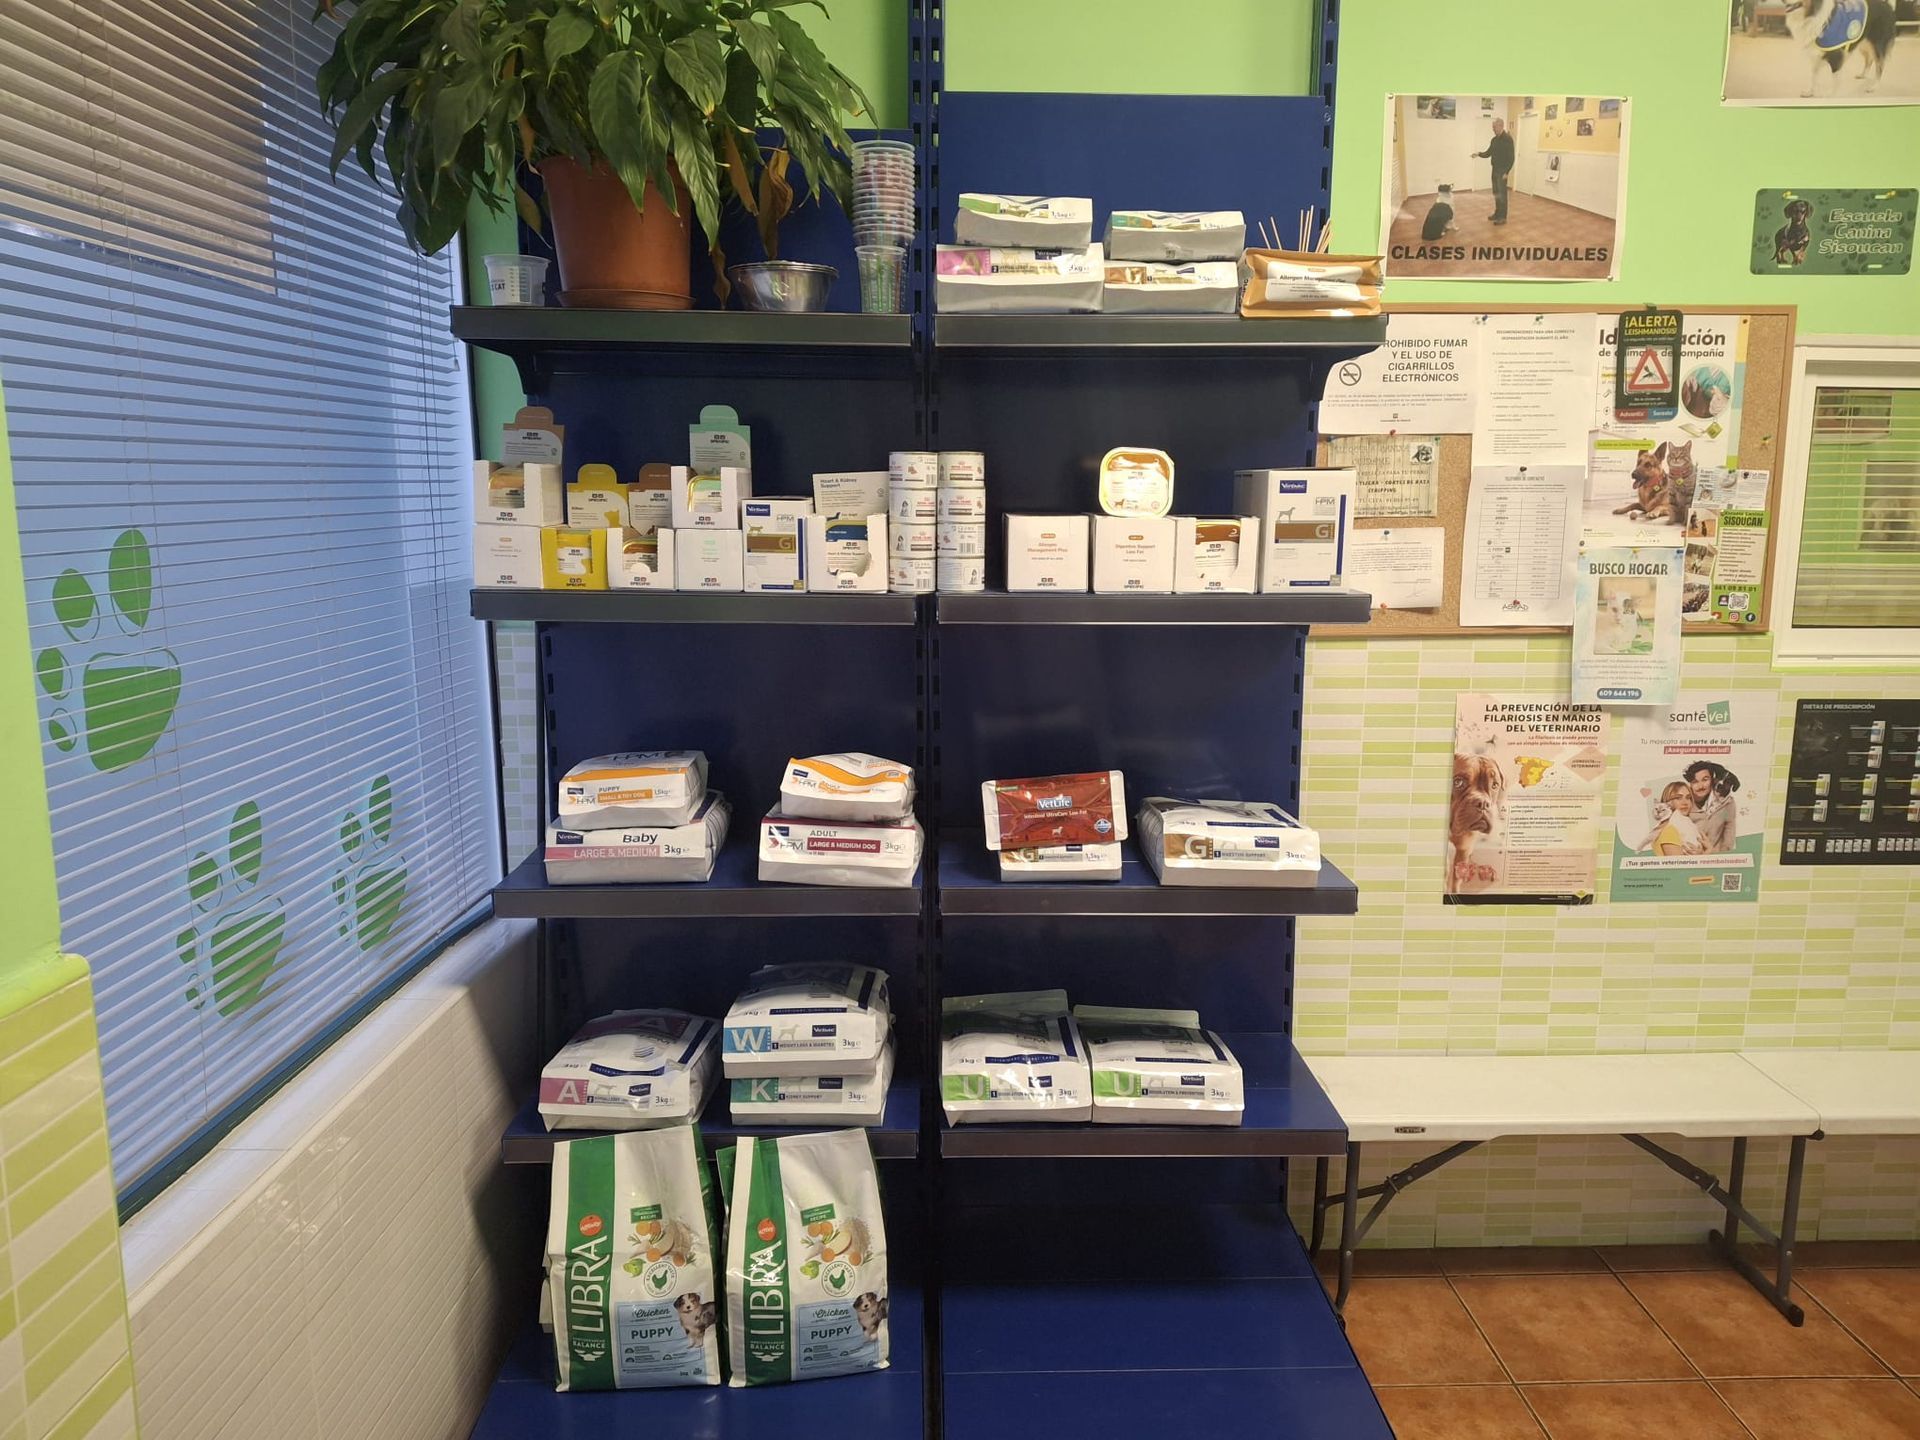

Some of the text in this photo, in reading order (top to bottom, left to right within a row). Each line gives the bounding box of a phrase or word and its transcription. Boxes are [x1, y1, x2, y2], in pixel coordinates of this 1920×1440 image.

[1829, 209, 1902, 223] Escuela
[1835, 224, 1892, 238] Canina
[1819, 240, 1903, 254] Sisoucan
[1391, 246, 1608, 262] CLASES INDIVIDUALES
[1625, 315, 1677, 328] ¡ALERTA
[1384, 339, 1468, 348] ROHIBIDO FUMAR
[1392, 351, 1452, 359] Y EL USO DE
[1681, 348, 1724, 359] ompañía
[1388, 362, 1455, 371] CIGARRILLOS
[1382, 373, 1459, 382] ELECTRÓNICOS
[1724, 516, 1763, 527] SISOUCAN
[1590, 563, 1668, 575] BUSCO HOGAR
[1486, 704, 1498, 712] LA
[1501, 702, 1569, 712] PREVENCIÓN
[1484, 714, 1542, 722] FILARIOSIS
[1545, 714, 1559, 722] EN
[1038, 798, 1071, 809] VetLife
[623, 833, 658, 845] Baby
[574, 847, 657, 858] LARGE & MEDIUM
[1184, 836, 1207, 858] G
[731, 1029, 766, 1051] W
[751, 1079, 772, 1101] K
[1114, 1073, 1134, 1096] U
[557, 1081, 581, 1103] A
[571, 1235, 610, 1332] LIBRA
[750, 1240, 786, 1335] LIBRA
[634, 1307, 670, 1319] Chicken
[816, 1308, 850, 1319] Chicken
[631, 1327, 674, 1339] PUPPY
[811, 1325, 852, 1340] PUPPY
[573, 1341, 606, 1349] BALANCE
